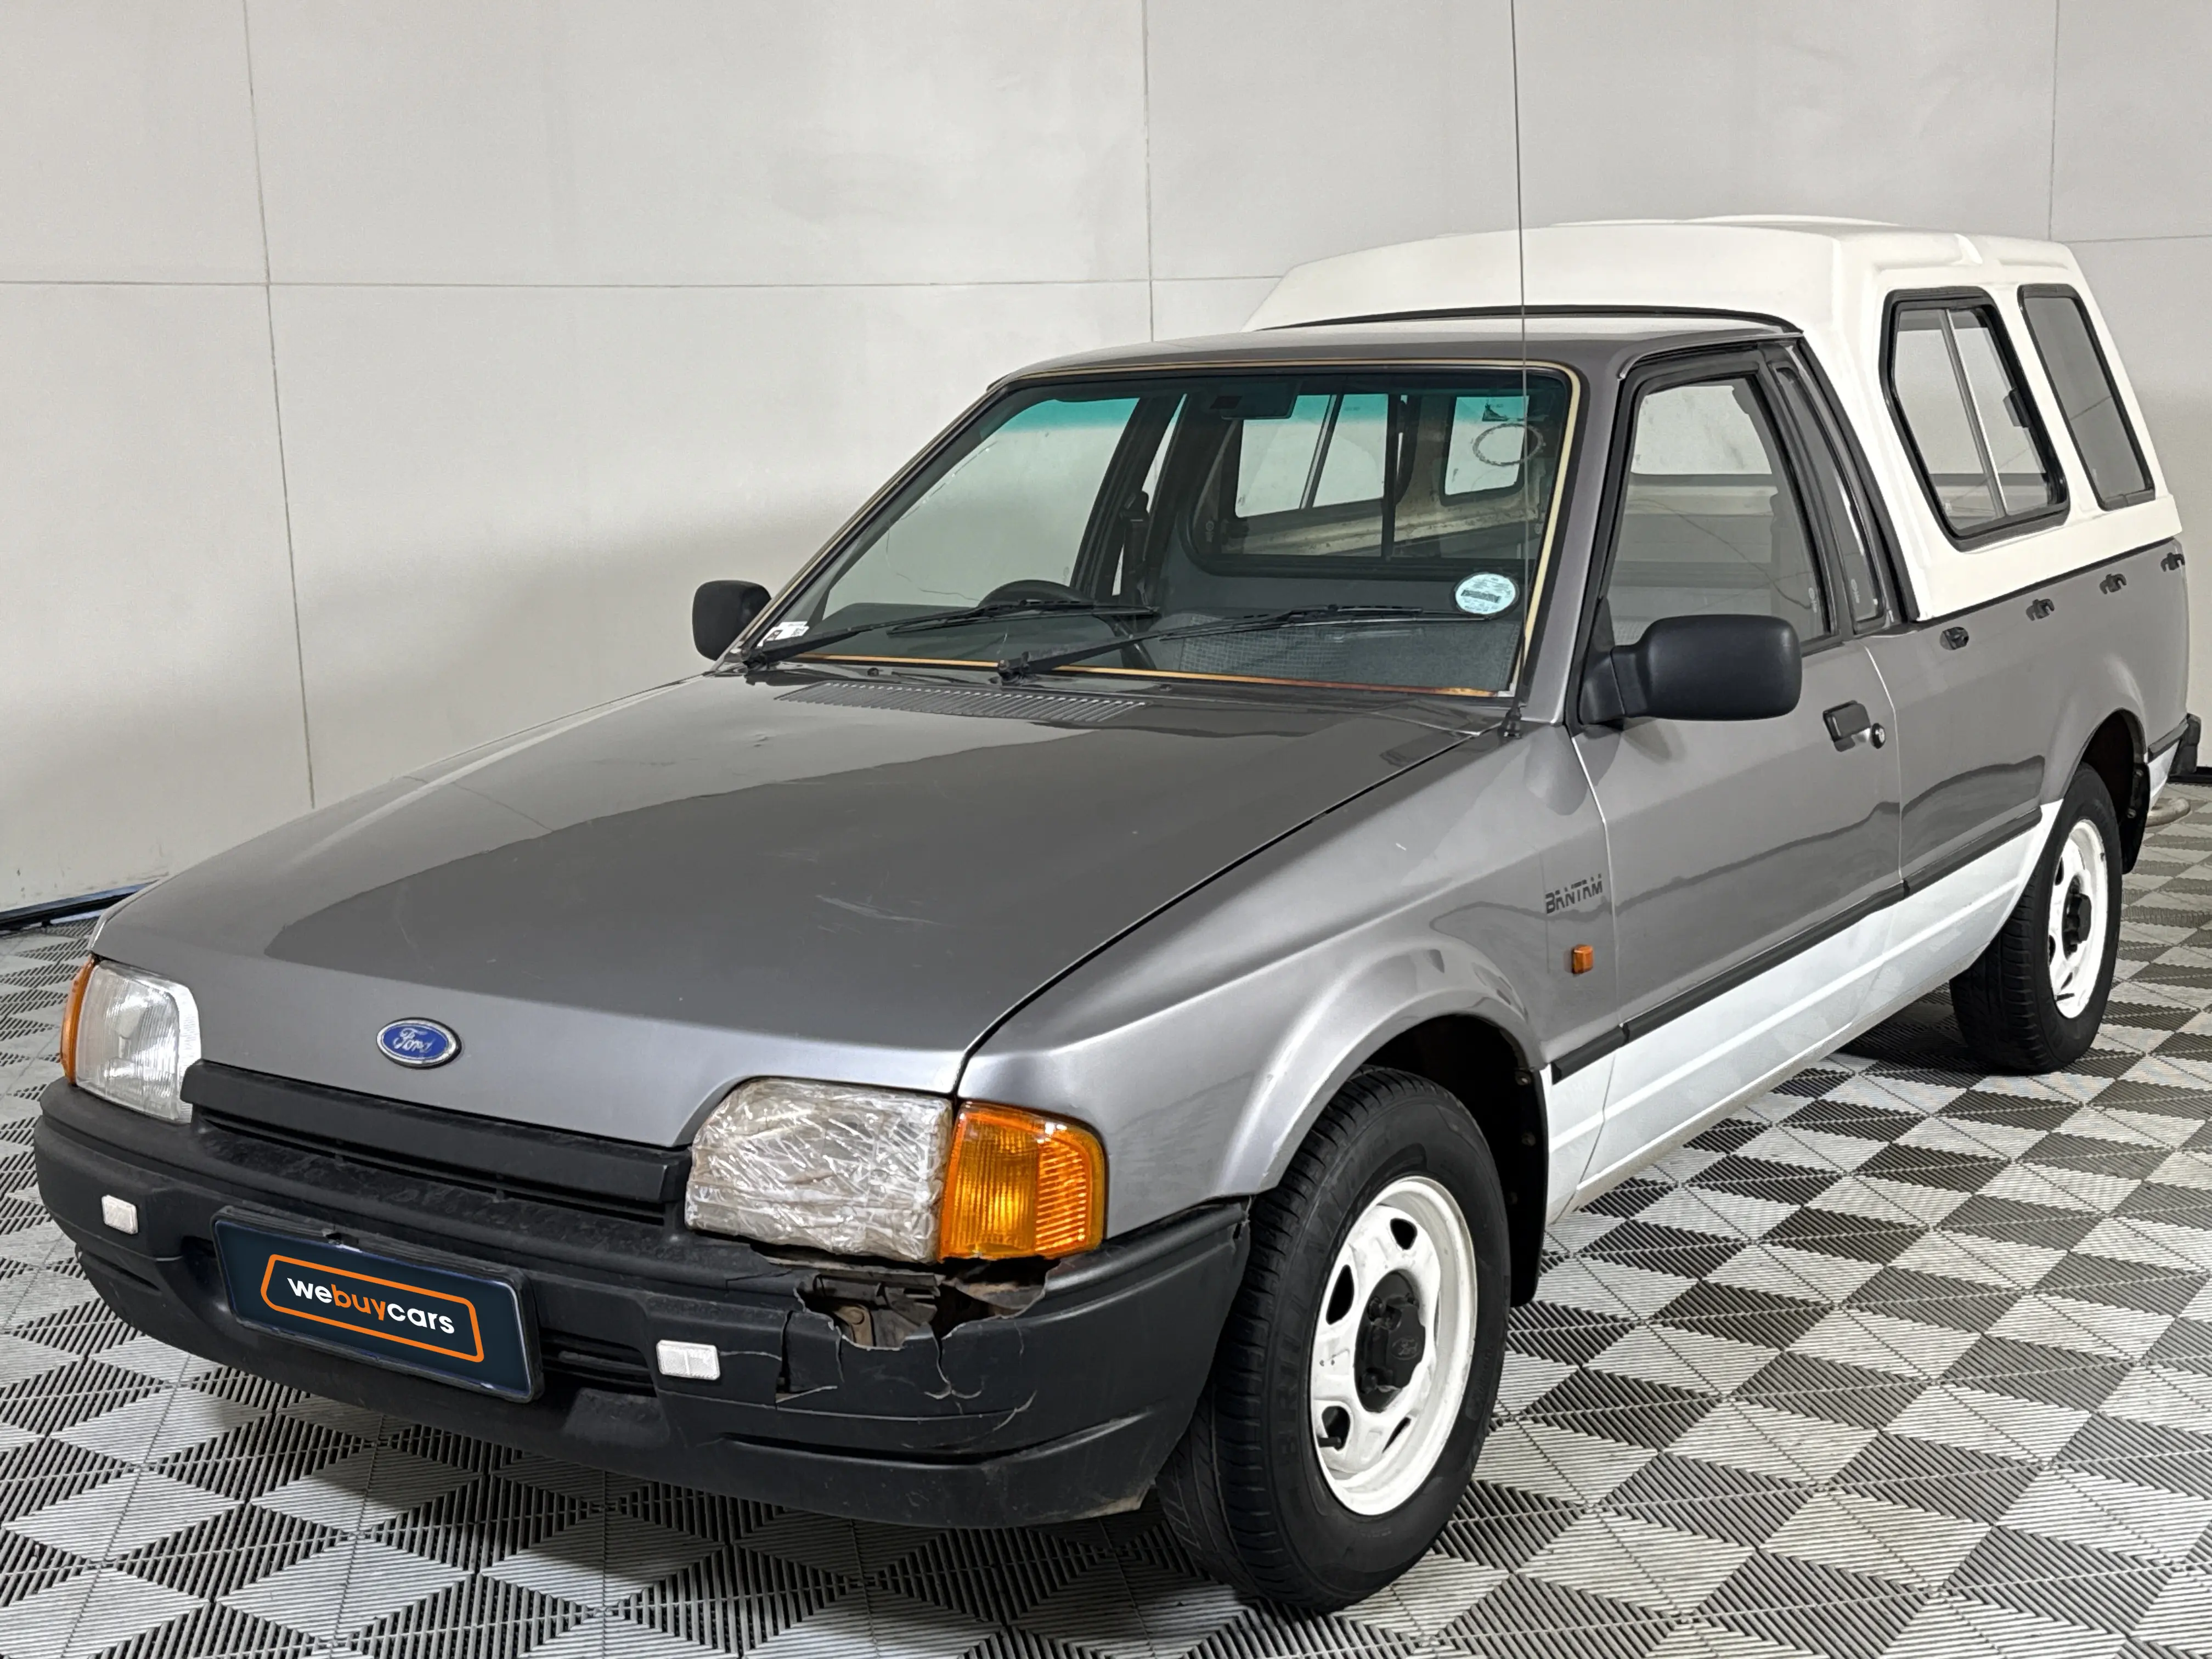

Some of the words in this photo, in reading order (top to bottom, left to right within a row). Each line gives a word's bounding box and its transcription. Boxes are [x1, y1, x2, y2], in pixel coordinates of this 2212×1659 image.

[1545, 873, 1603, 914] BANTAM
[392, 1027, 437, 1054] Ford
[287, 1278, 455, 1334] webuycars
